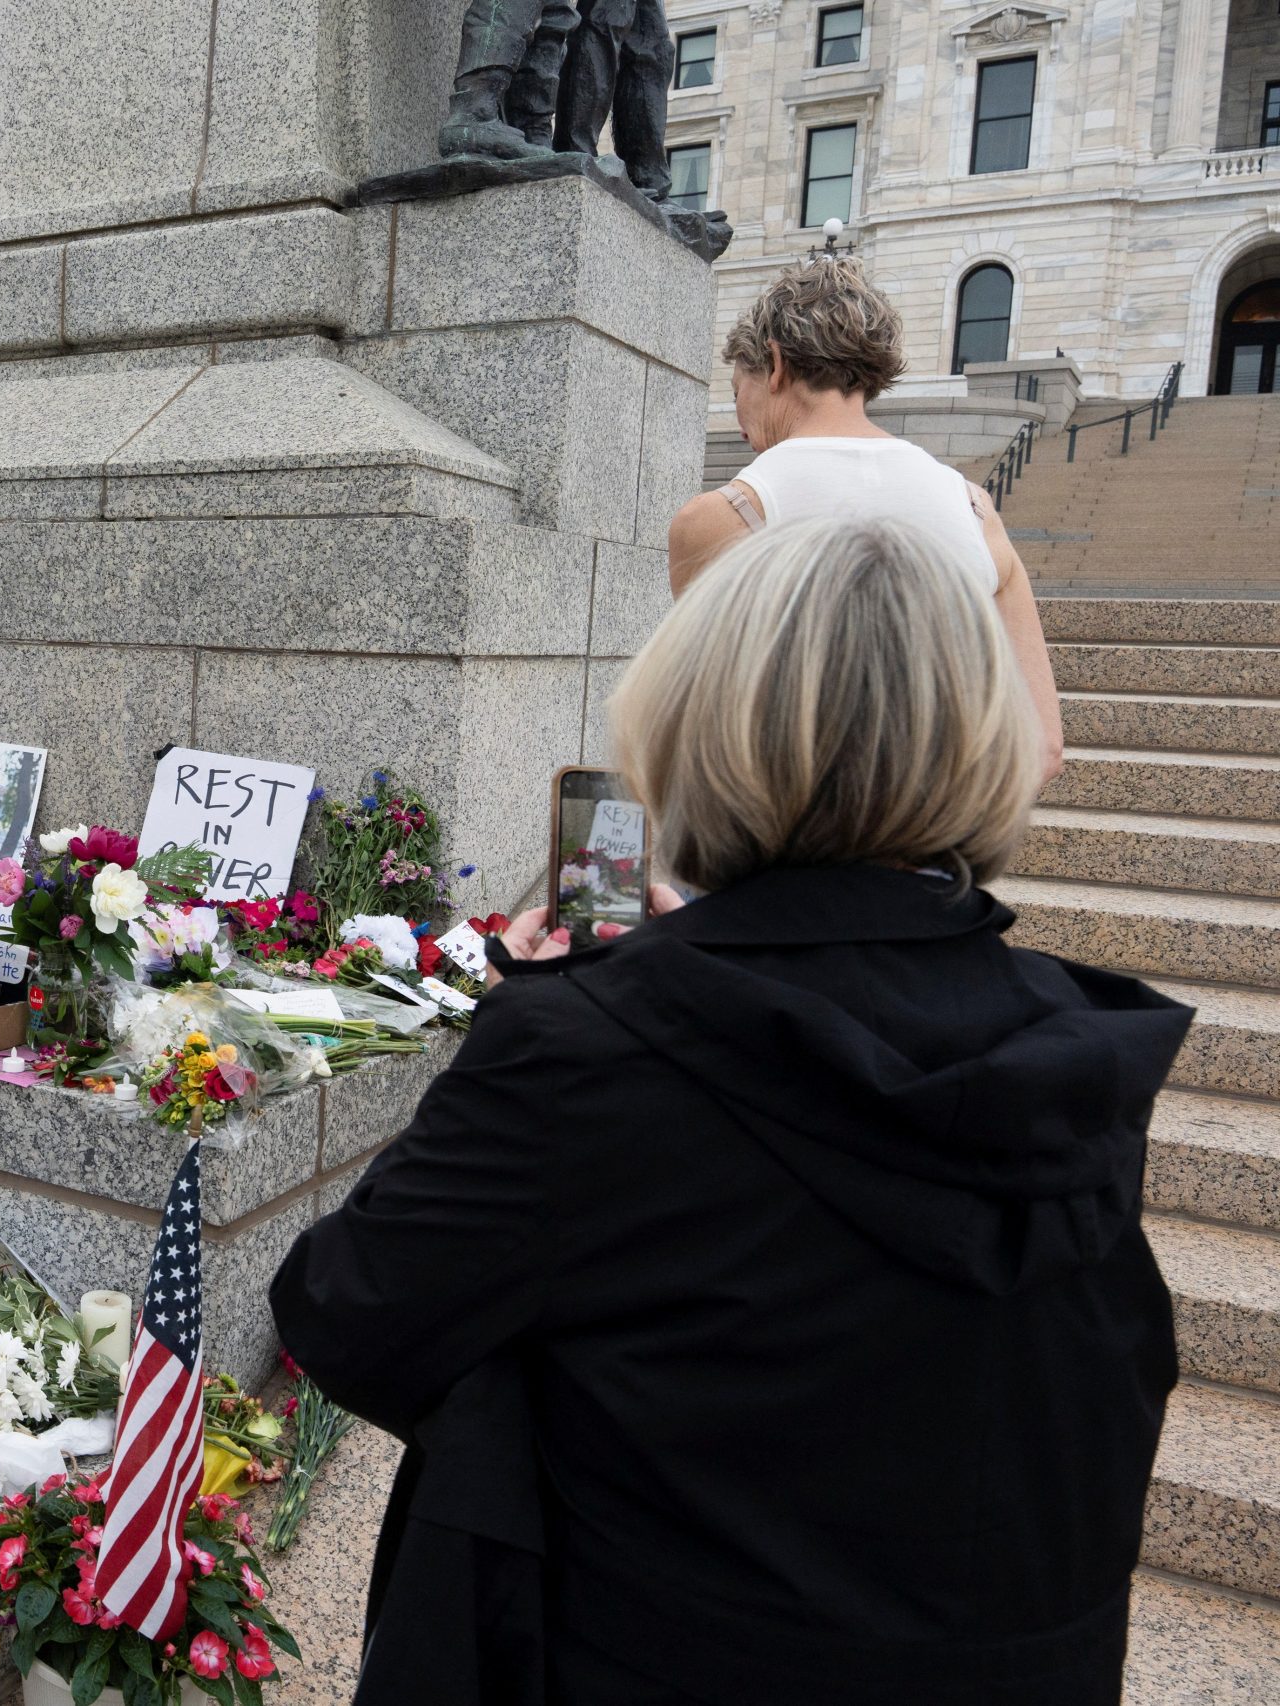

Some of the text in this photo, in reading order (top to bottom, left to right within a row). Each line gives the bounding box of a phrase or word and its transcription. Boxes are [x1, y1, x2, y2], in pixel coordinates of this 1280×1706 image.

[175, 764, 296, 827] REST
[601, 804, 644, 829] REST
[202, 821, 233, 845] IN
[611, 827, 623, 837] IN
